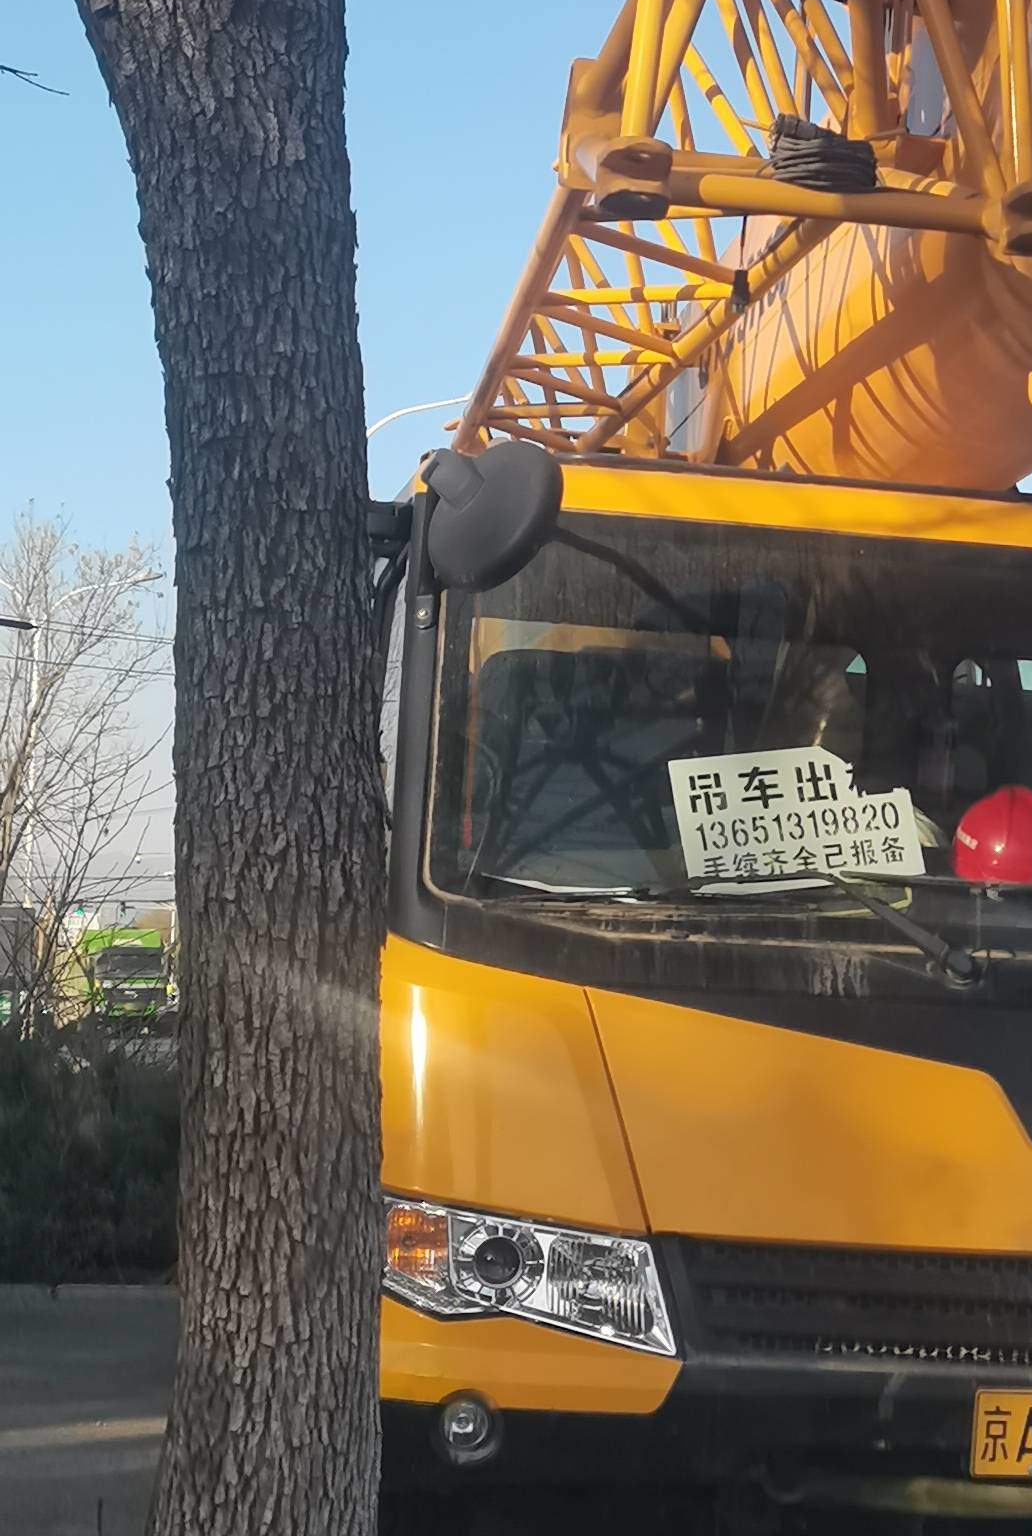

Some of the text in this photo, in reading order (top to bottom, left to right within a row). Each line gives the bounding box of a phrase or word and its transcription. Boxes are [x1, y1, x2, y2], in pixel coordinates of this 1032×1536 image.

[688, 761, 864, 815] 吊车出
[695, 801, 900, 851] 13651319820
